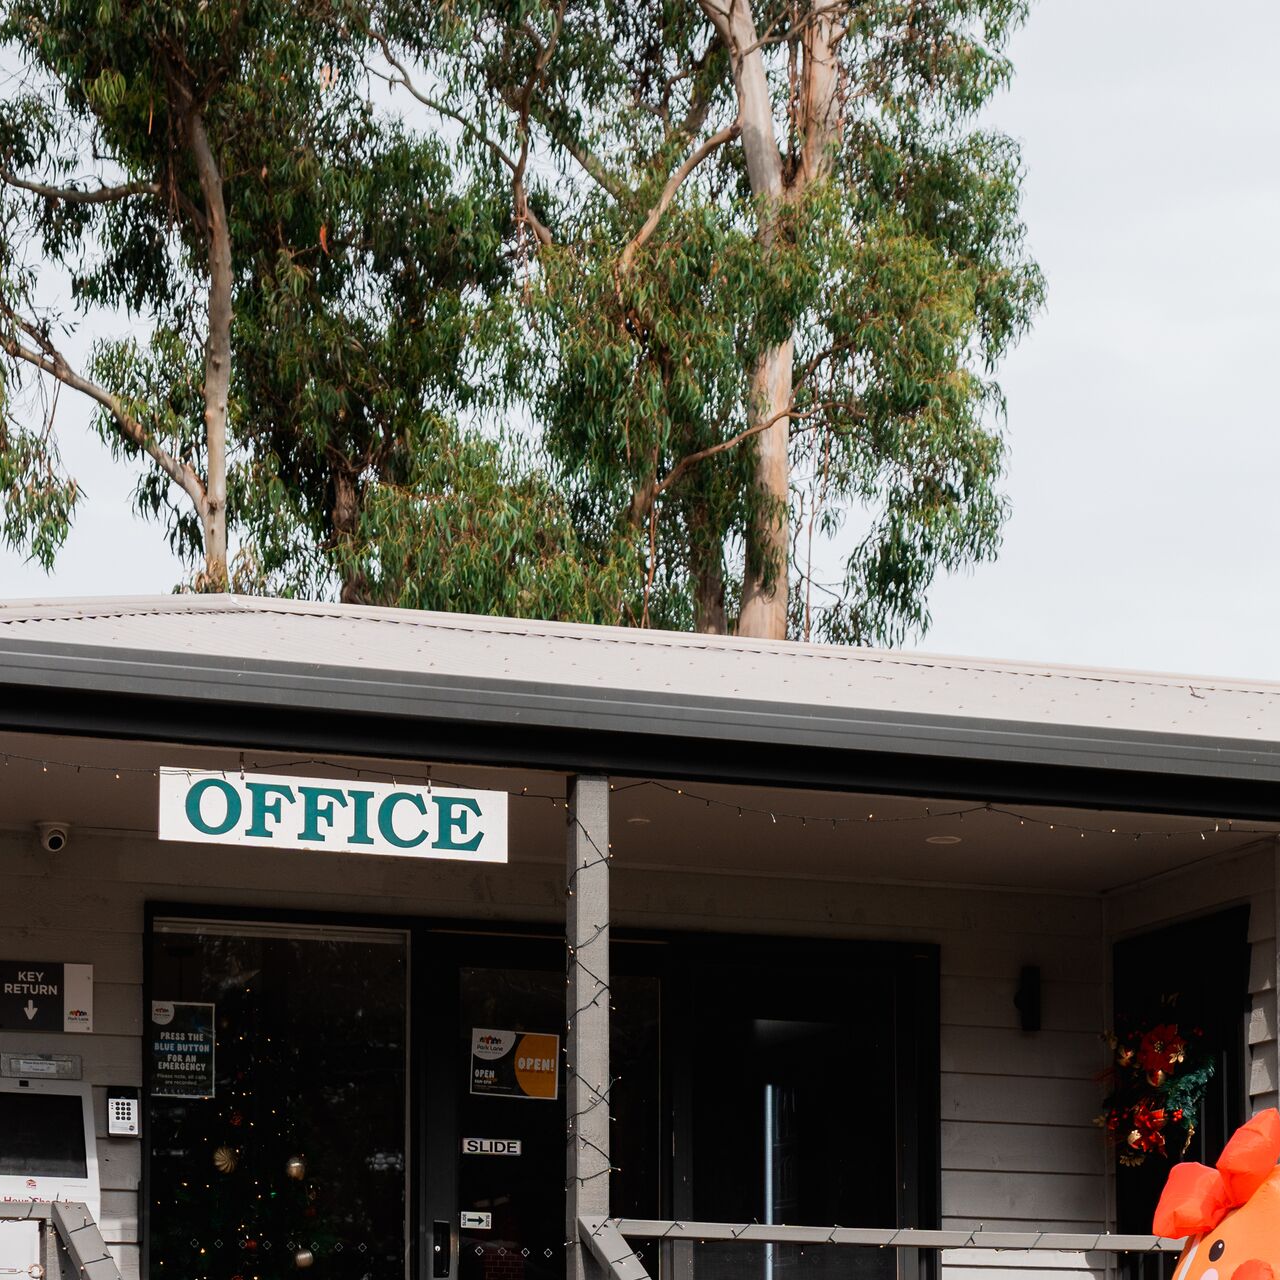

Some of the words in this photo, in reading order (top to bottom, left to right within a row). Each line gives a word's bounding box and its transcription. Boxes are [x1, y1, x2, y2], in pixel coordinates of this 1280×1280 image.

[185, 777, 485, 851] OFFICE
[18, 971, 44, 982] KEY
[4, 983, 58, 995] RETURN
[160, 1032, 186, 1041] PRESS
[187, 1033, 204, 1042] THE
[154, 1042, 175, 1051] BLUE
[176, 1043, 210, 1053] BUTTON
[167, 1054, 183, 1063] FOR
[185, 1054, 197, 1063] AN
[157, 1062, 206, 1072] EMERGENCY
[518, 1057, 555, 1072] OPEN!
[474, 1069, 495, 1078] OPEN
[467, 1140, 517, 1153] SLIDE
